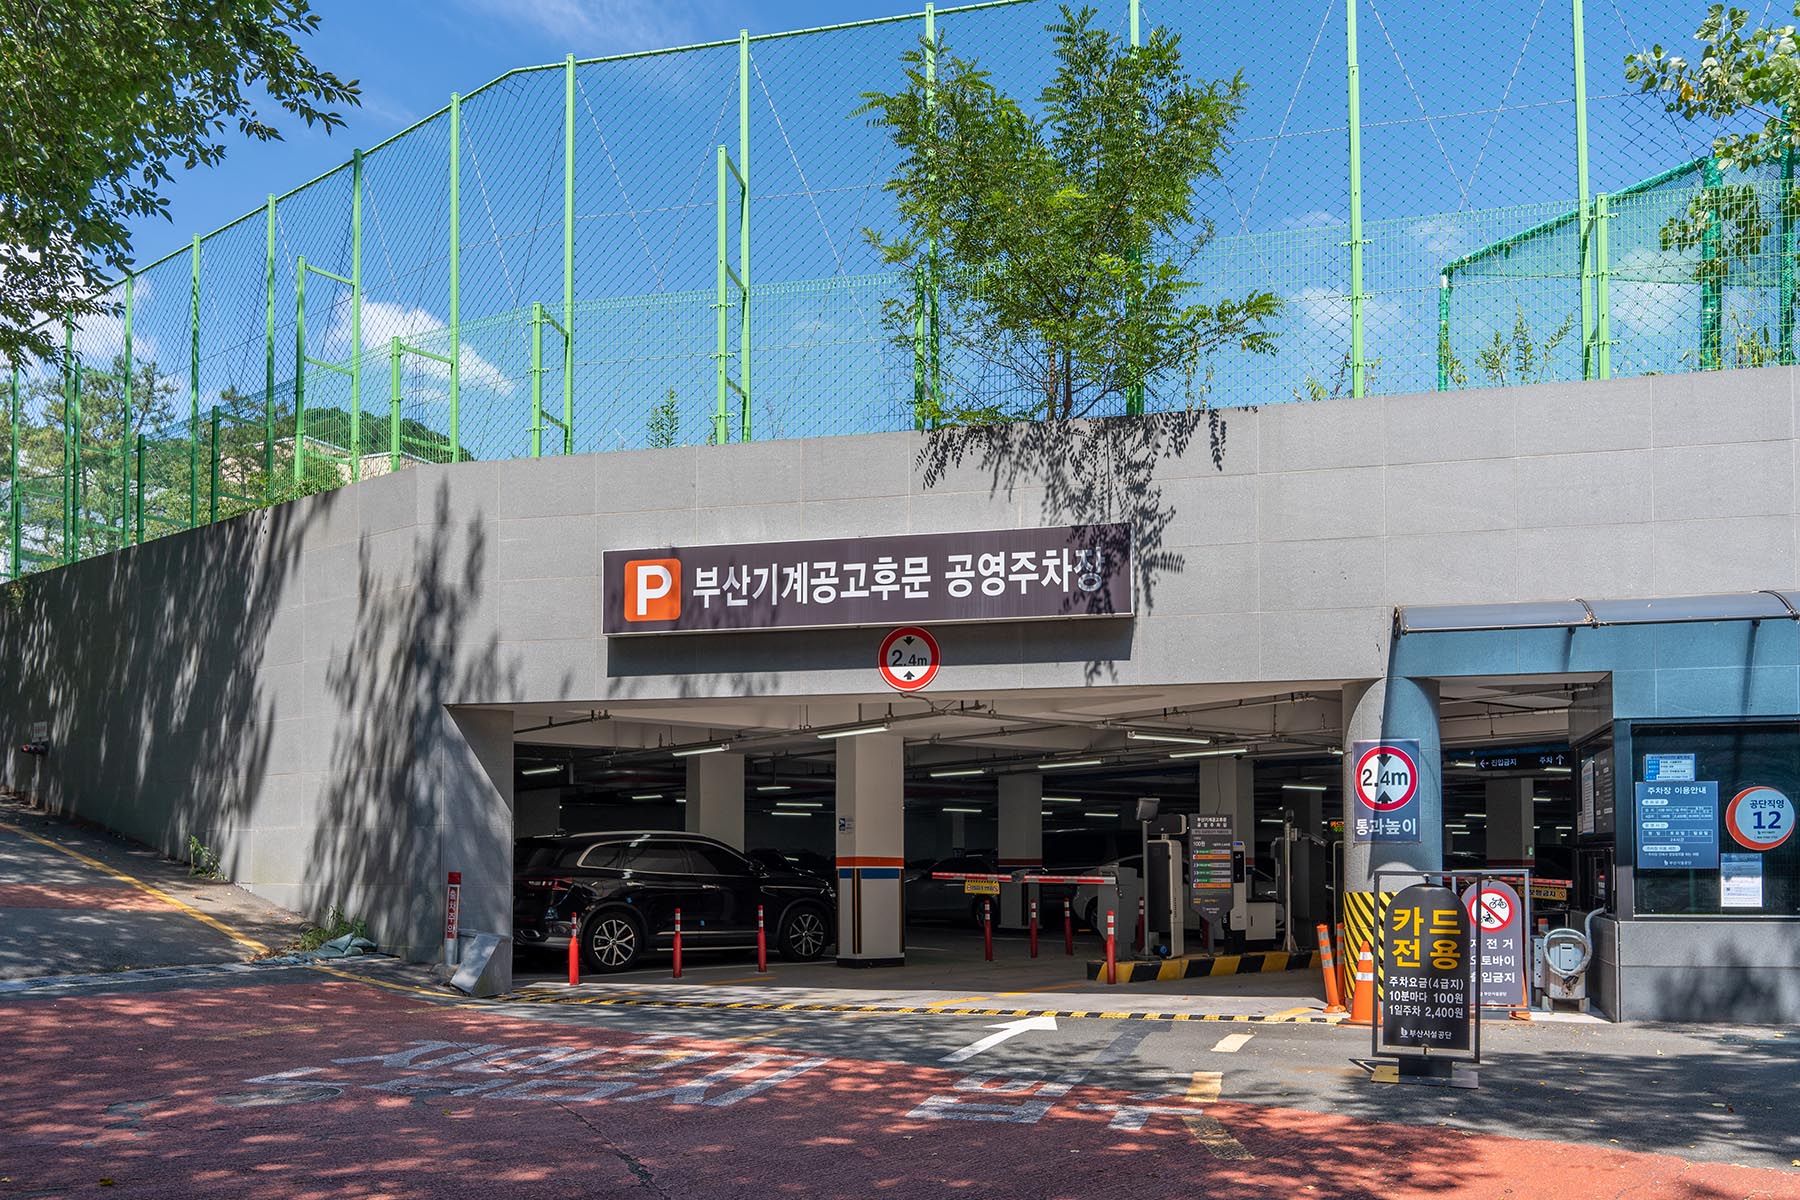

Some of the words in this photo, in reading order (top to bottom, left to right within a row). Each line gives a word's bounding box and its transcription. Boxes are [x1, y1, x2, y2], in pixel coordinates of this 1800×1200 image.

[637, 565, 672, 616] P
[693, 556, 932, 609] 부산기계공고후문
[945, 547, 1104, 598] 공영주차장
[892, 649, 928, 667] 2.4m
[1491, 758, 1517, 767] 진입금지
[1539, 756, 1553, 764] 주차
[1362, 769, 1408, 787] 2.4m
[1648, 786, 1671, 795] 주차장
[1674, 786, 1707, 795] 이용안내
[1749, 799, 1785, 809] 공단직영
[1356, 818, 1416, 836] 통과높이
[1753, 811, 1782, 830] 12
[1392, 906, 1462, 937] 카드
[1391, 938, 1462, 970] 전용
[1389, 976, 1464, 990] 주차요금(4급지)
[1389, 990, 1427, 1003] 10분마다
[1433, 993, 1464, 1005] 100원
[1389, 1004, 1421, 1017] 1일주차
[1425, 1006, 1464, 1019] 2,400원
[1409, 1029, 1452, 1040] 부산시설공단
